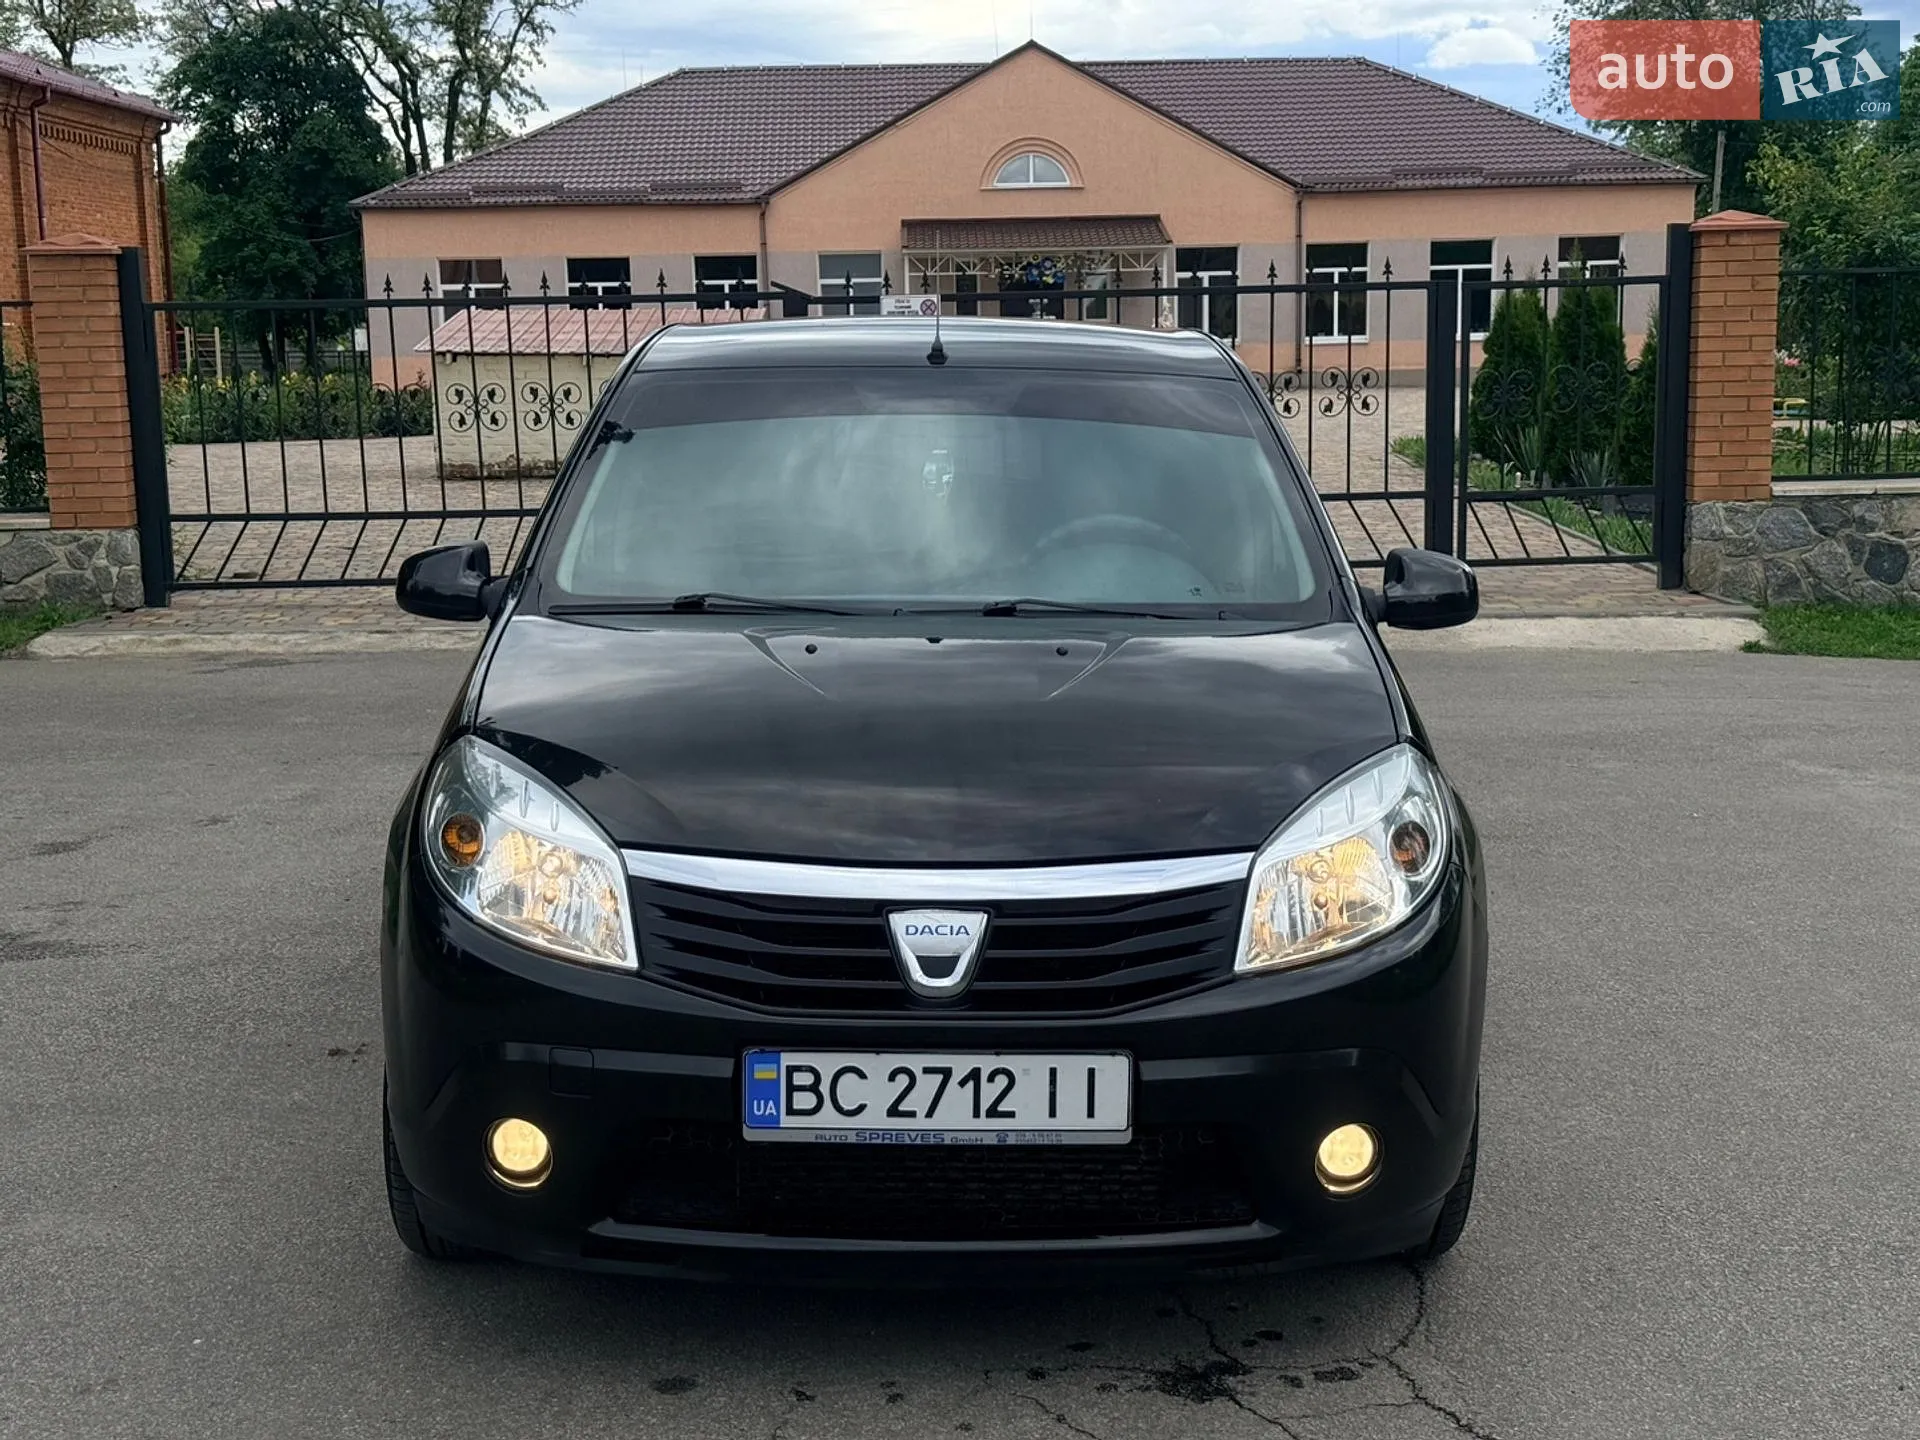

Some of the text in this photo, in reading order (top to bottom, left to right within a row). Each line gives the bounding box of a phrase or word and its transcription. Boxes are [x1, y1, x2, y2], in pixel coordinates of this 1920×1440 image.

[905, 924, 971, 936] DACIA
[785, 1064, 869, 1117] BC
[886, 1066, 1017, 1119] 2712
[753, 1100, 777, 1116] UA
[854, 1130, 946, 1144] SPREVES
[949, 1135, 984, 1145] GmbH
